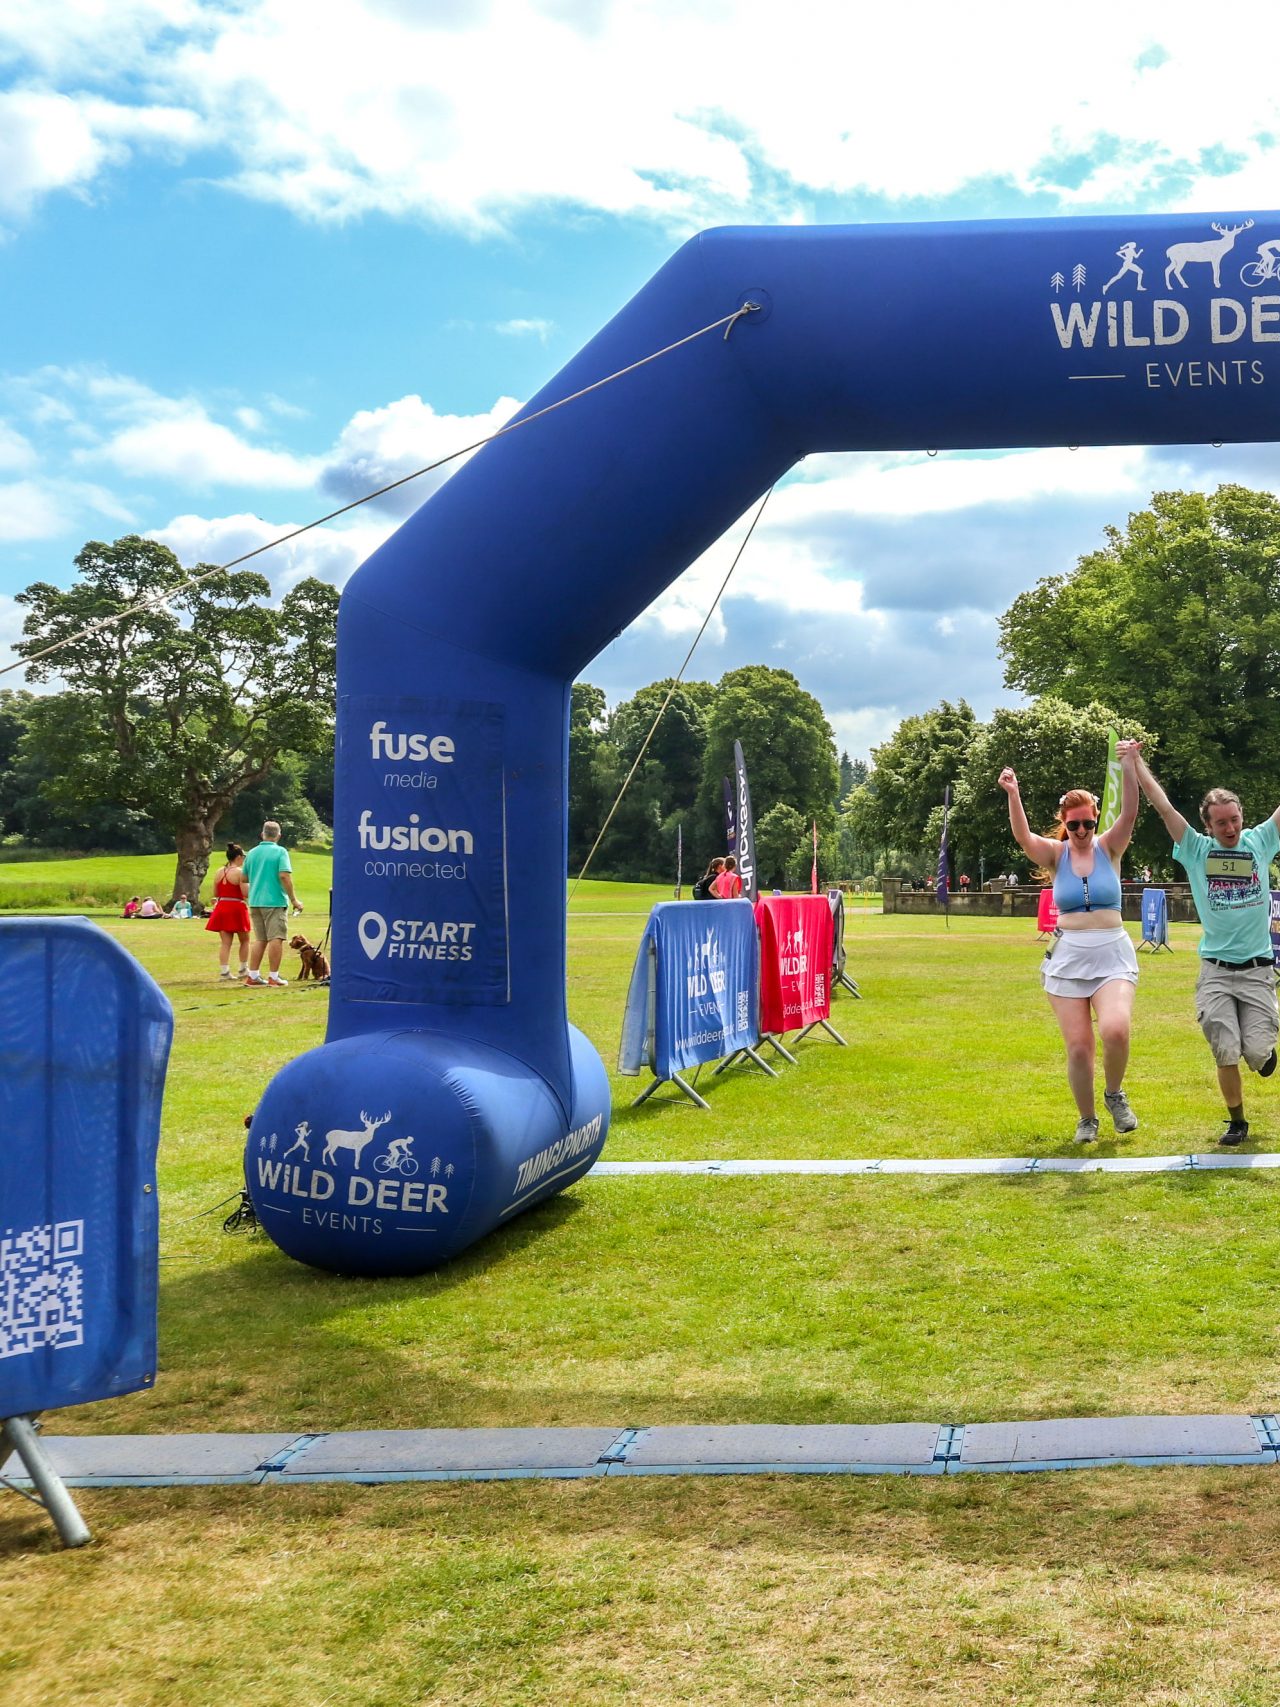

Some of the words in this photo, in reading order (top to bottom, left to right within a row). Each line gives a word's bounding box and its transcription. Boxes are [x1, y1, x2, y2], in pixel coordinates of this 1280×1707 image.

[1050, 300, 1189, 348] WILD
[1146, 360, 1264, 387] EVENTS
[369, 721, 455, 763] fuse
[384, 771, 438, 789] media
[358, 810, 474, 855] fusion
[364, 860, 467, 880] connected
[1221, 861, 1236, 871] 51
[390, 919, 476, 944] START
[388, 943, 473, 961] FITNESS
[513, 1112, 603, 1196] TIMINGUPNORTH
[257, 1158, 335, 1200] WILD
[348, 1176, 449, 1213] DEER
[303, 1208, 383, 1235] EVENTS
